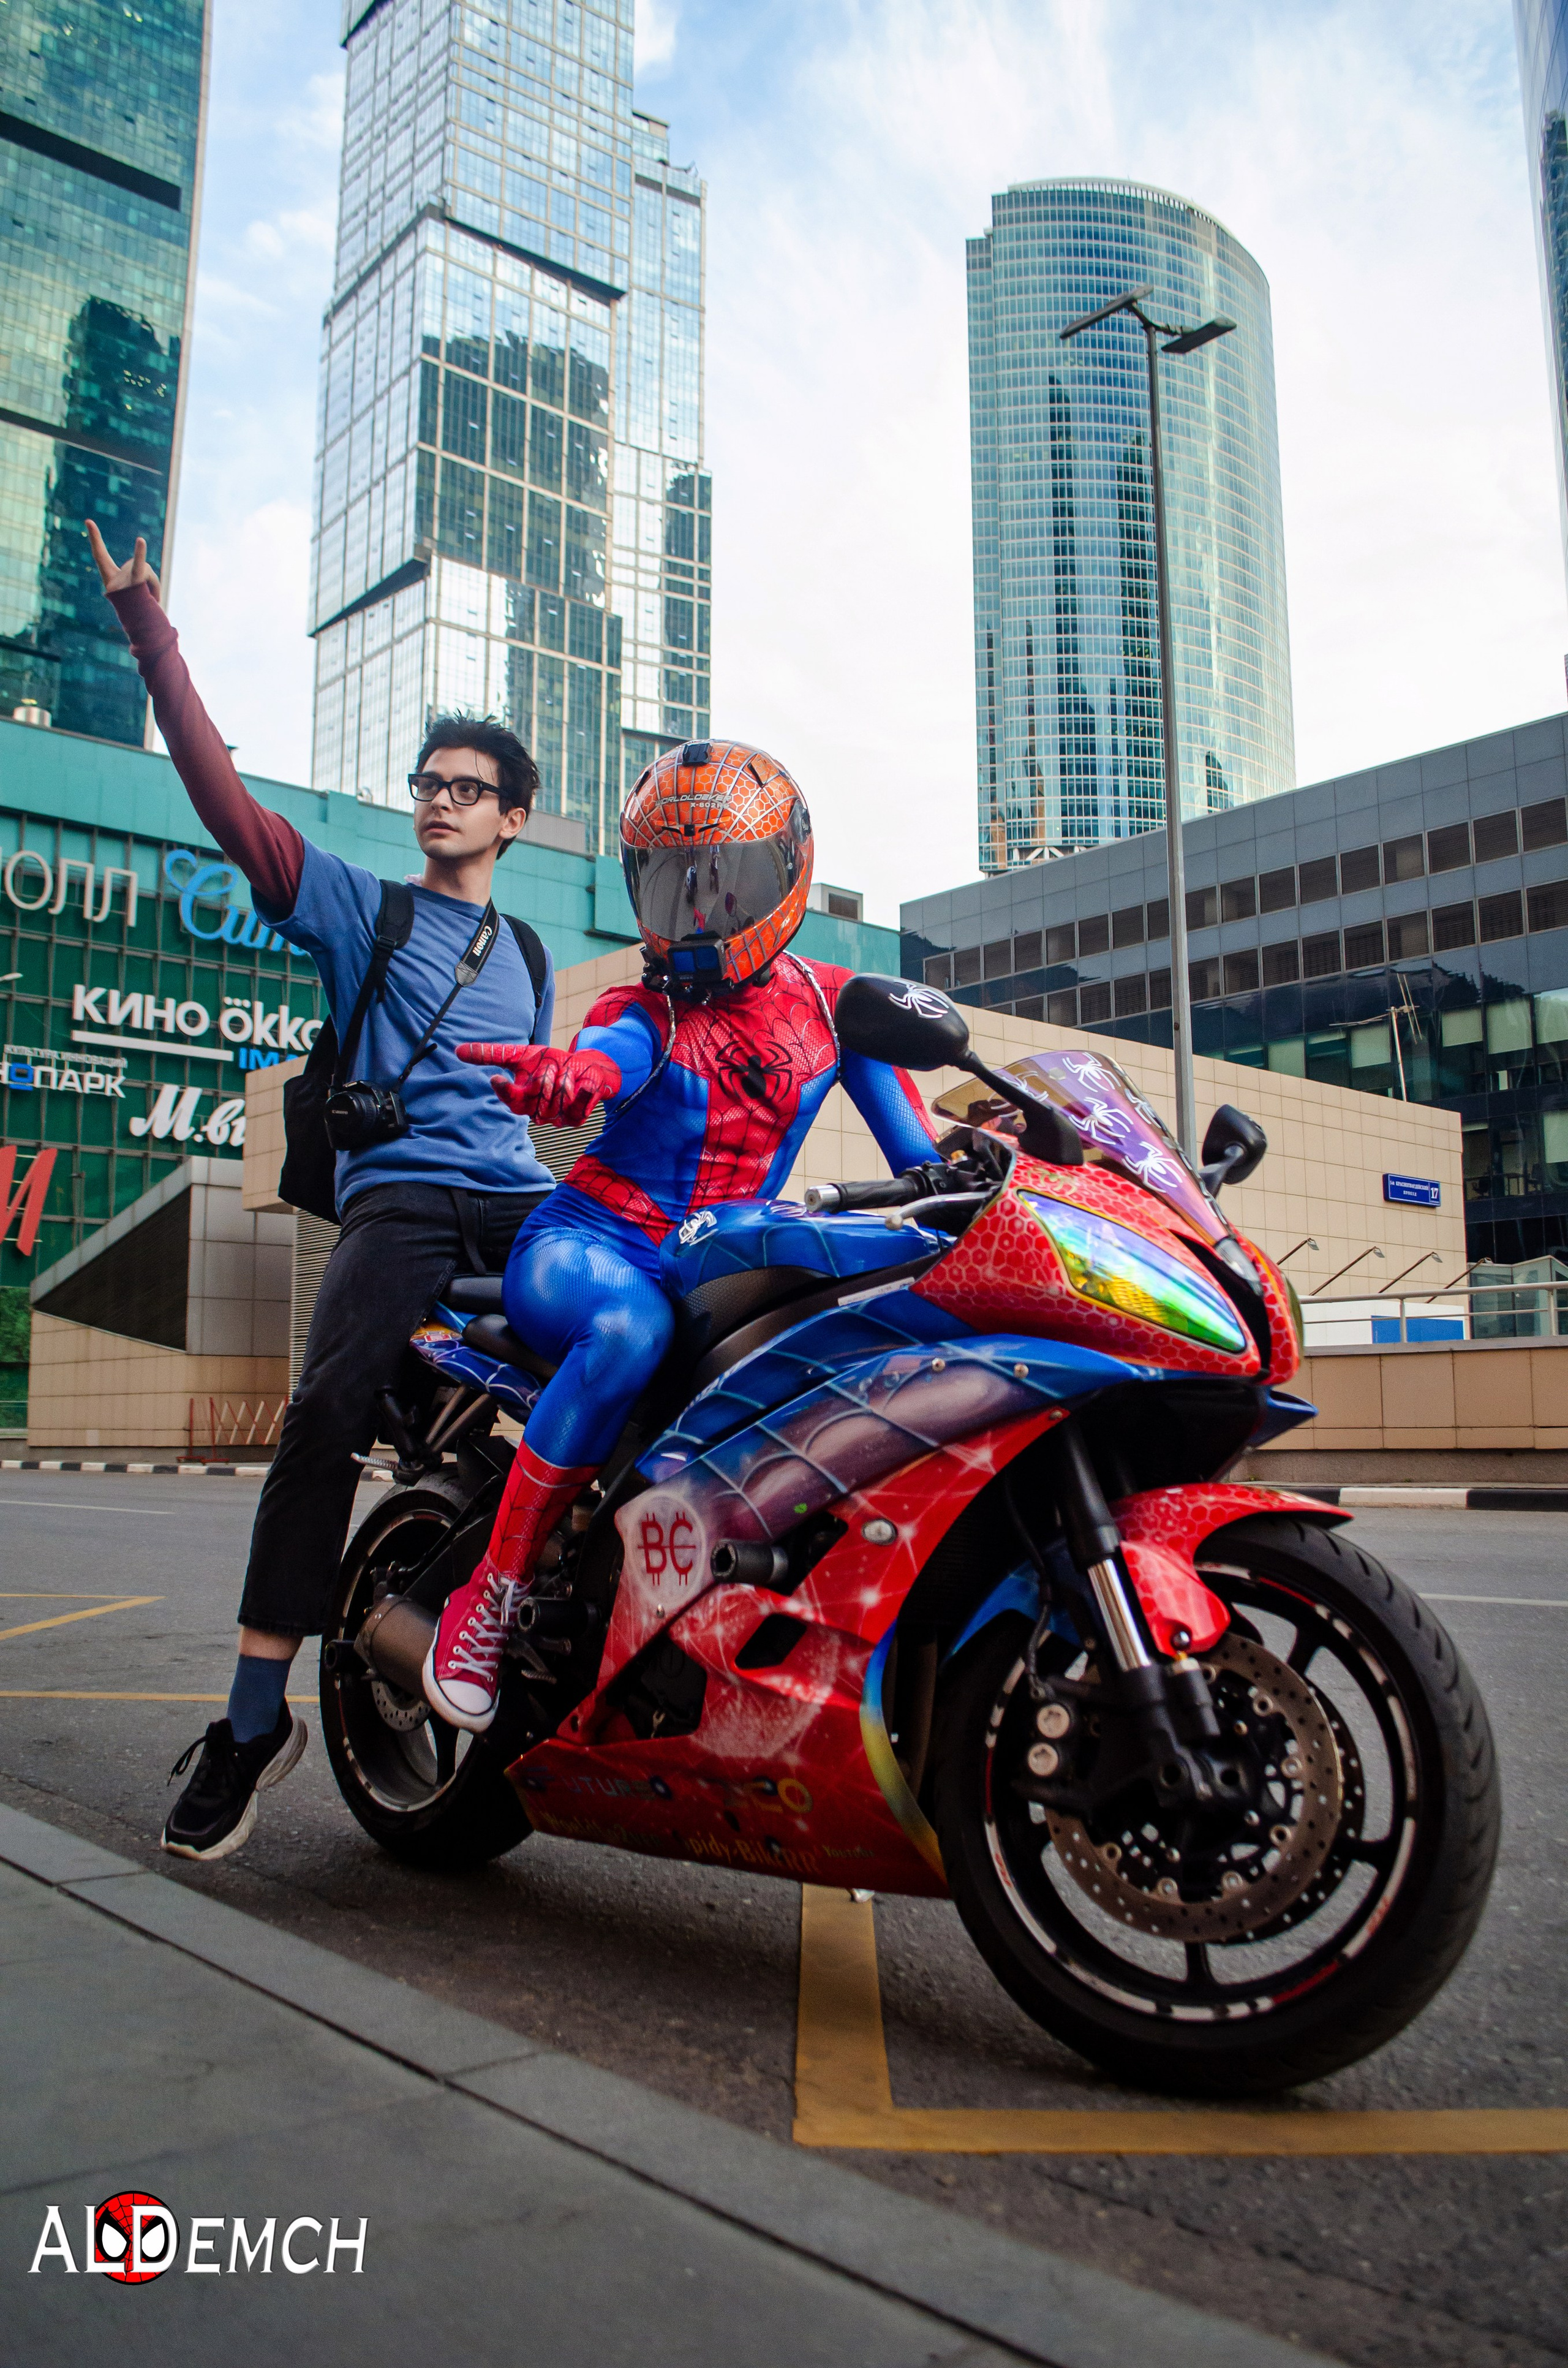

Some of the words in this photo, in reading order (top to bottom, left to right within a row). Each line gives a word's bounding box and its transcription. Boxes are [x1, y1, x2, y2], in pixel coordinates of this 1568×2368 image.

[0, 847, 138, 927] ОЛЛ
[472, 925, 492, 956] Canon
[72, 984, 210, 1037] КИНО
[239, 1047, 299, 1070] IM
[1430, 1187, 1439, 1199] 17
